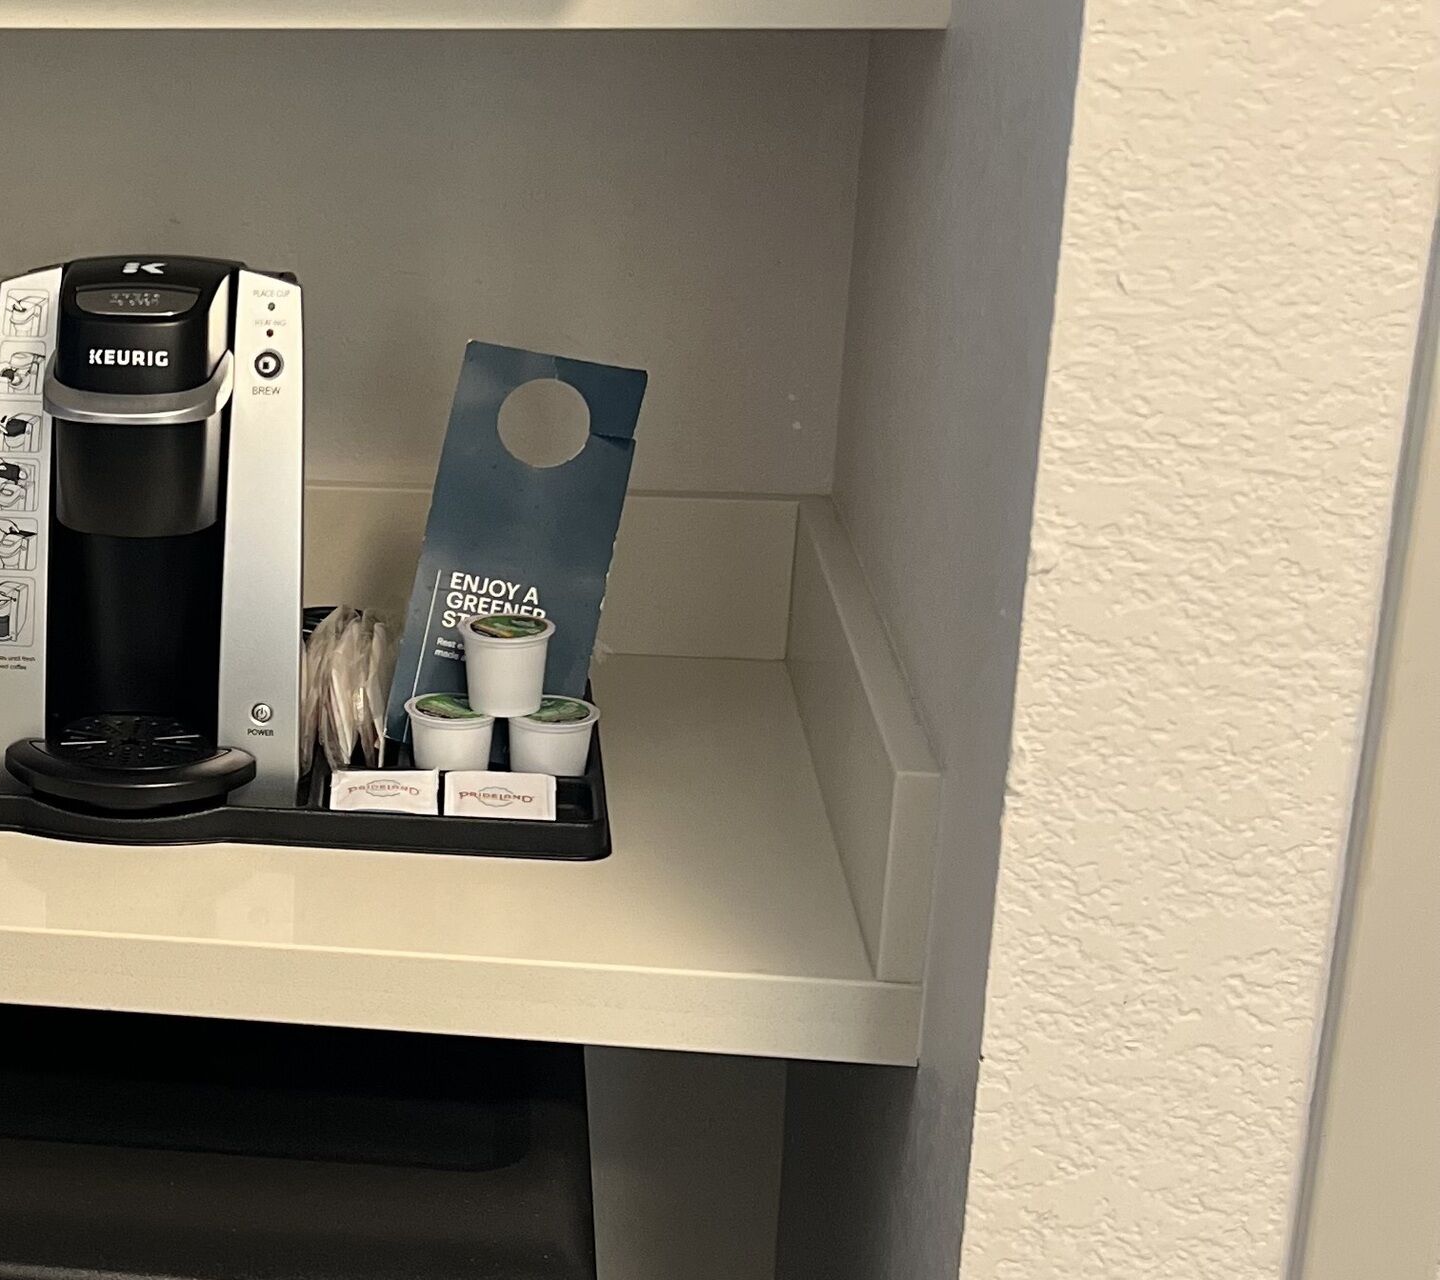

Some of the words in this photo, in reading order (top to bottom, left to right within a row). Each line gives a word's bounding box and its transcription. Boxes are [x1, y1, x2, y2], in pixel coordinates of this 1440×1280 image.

[88, 348, 169, 367] KEURIG
[251, 386, 281, 395] BREW
[449, 571, 520, 600] ENJOY
[522, 587, 539, 605] A
[247, 728, 274, 736] POWER
[459, 790, 533, 803] PRIDELAND
